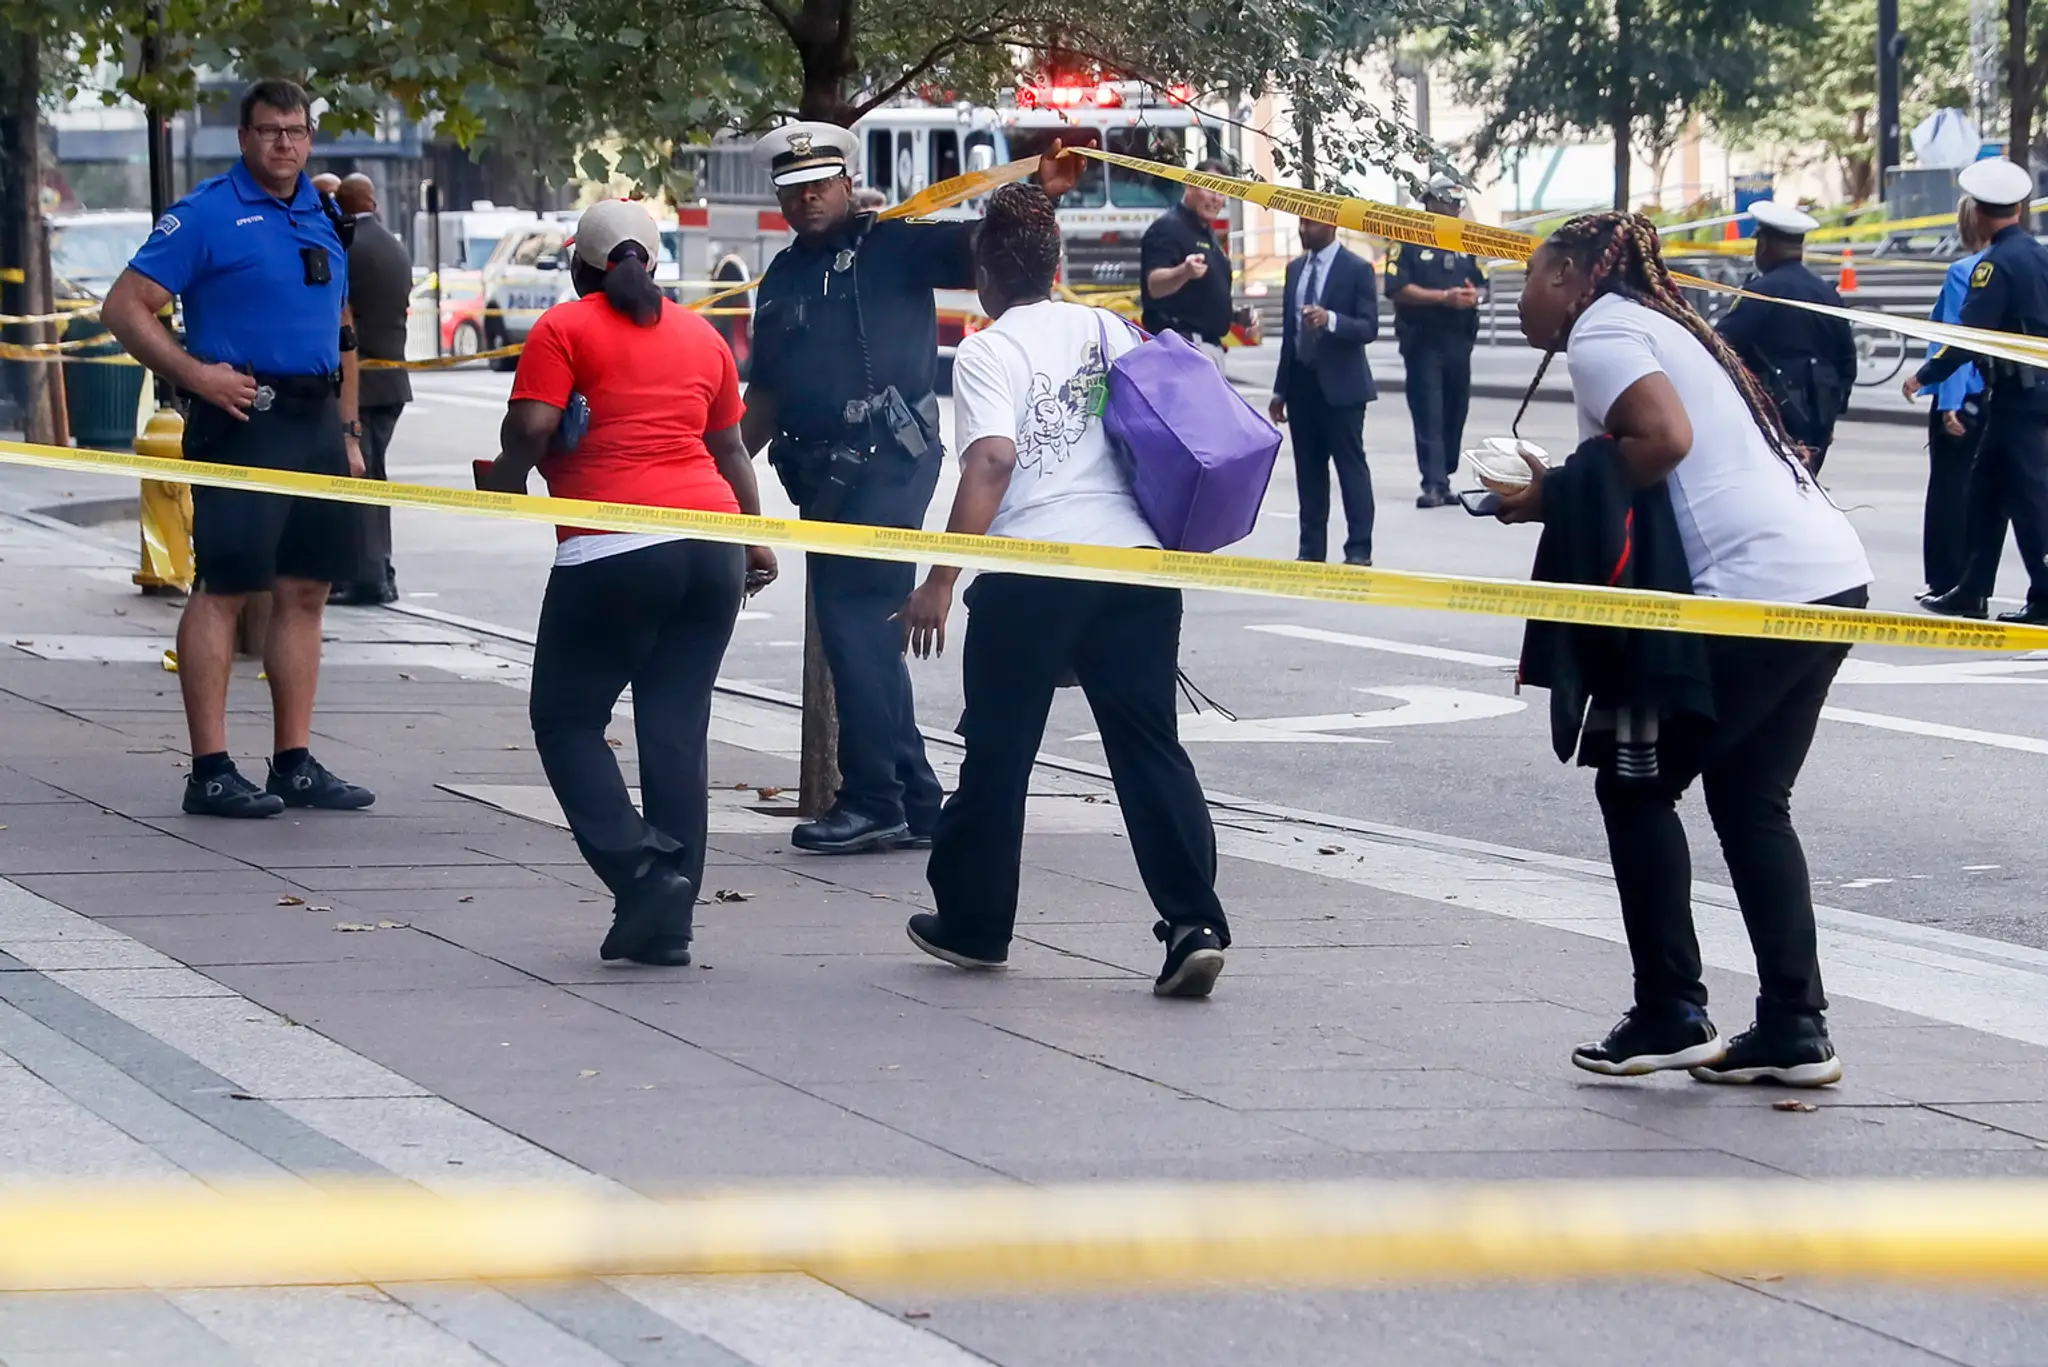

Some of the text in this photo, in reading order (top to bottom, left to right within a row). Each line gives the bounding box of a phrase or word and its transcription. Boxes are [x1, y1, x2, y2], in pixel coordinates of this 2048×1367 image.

[1265, 194, 1287, 210] CROSS
[1284, 199, 1299, 213] NOT
[1295, 202, 1307, 215] DO
[235, 214, 264, 227] EPPSTEIN
[1362, 218, 1380, 234] CROSS
[1381, 223, 1392, 237] NOT
[1394, 225, 1402, 239] DO
[1402, 227, 1416, 241] LINE
[1415, 230, 1437, 246] POLICE
[508, 292, 556, 309] POLICE
